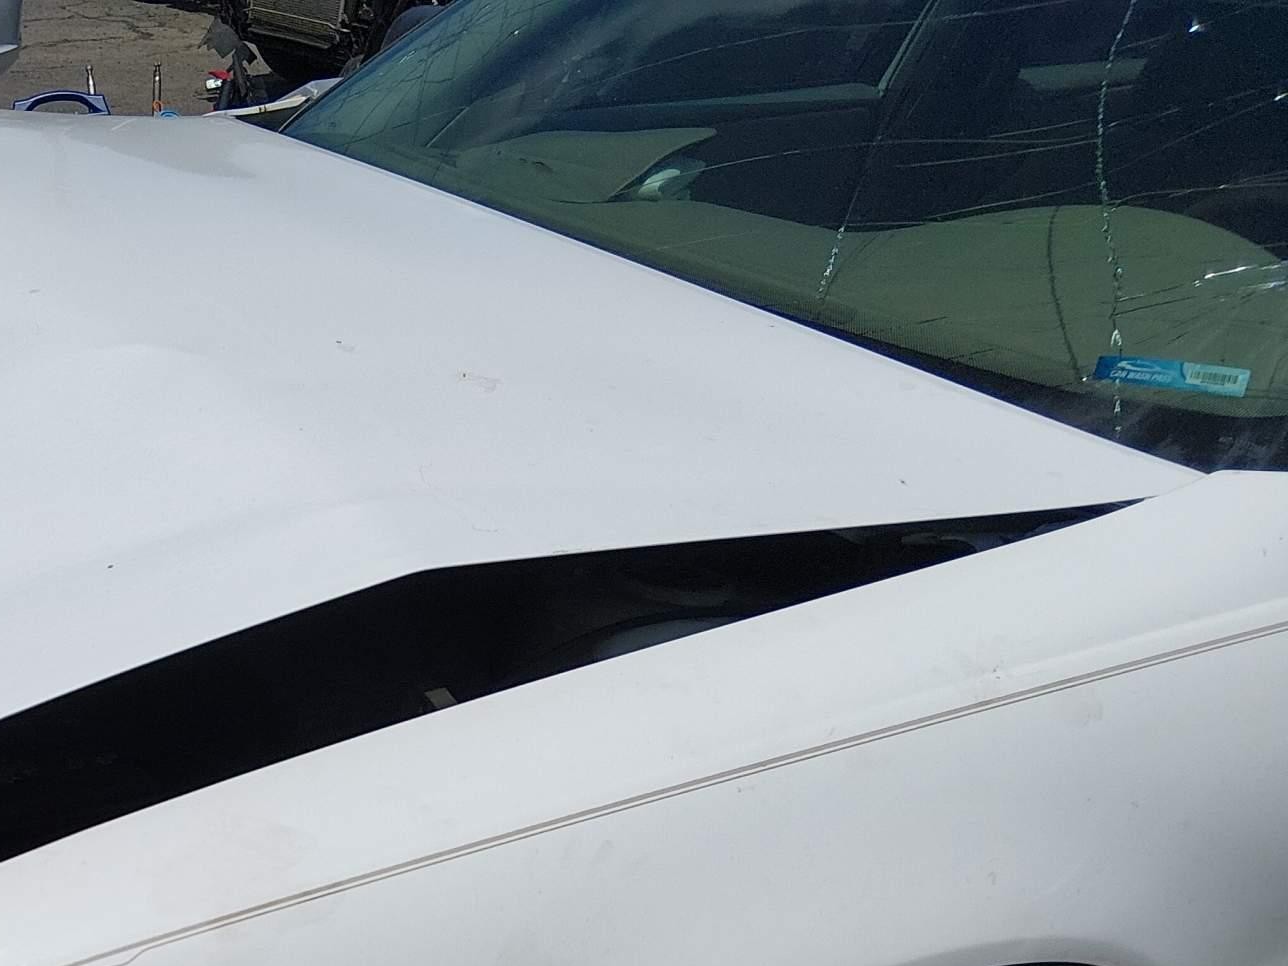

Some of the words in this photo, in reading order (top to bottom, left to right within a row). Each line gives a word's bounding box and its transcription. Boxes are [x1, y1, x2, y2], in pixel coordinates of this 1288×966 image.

[1110, 369, 1128, 378] CAR
[1127, 371, 1151, 380] WASH
[1151, 373, 1173, 383] PASS
